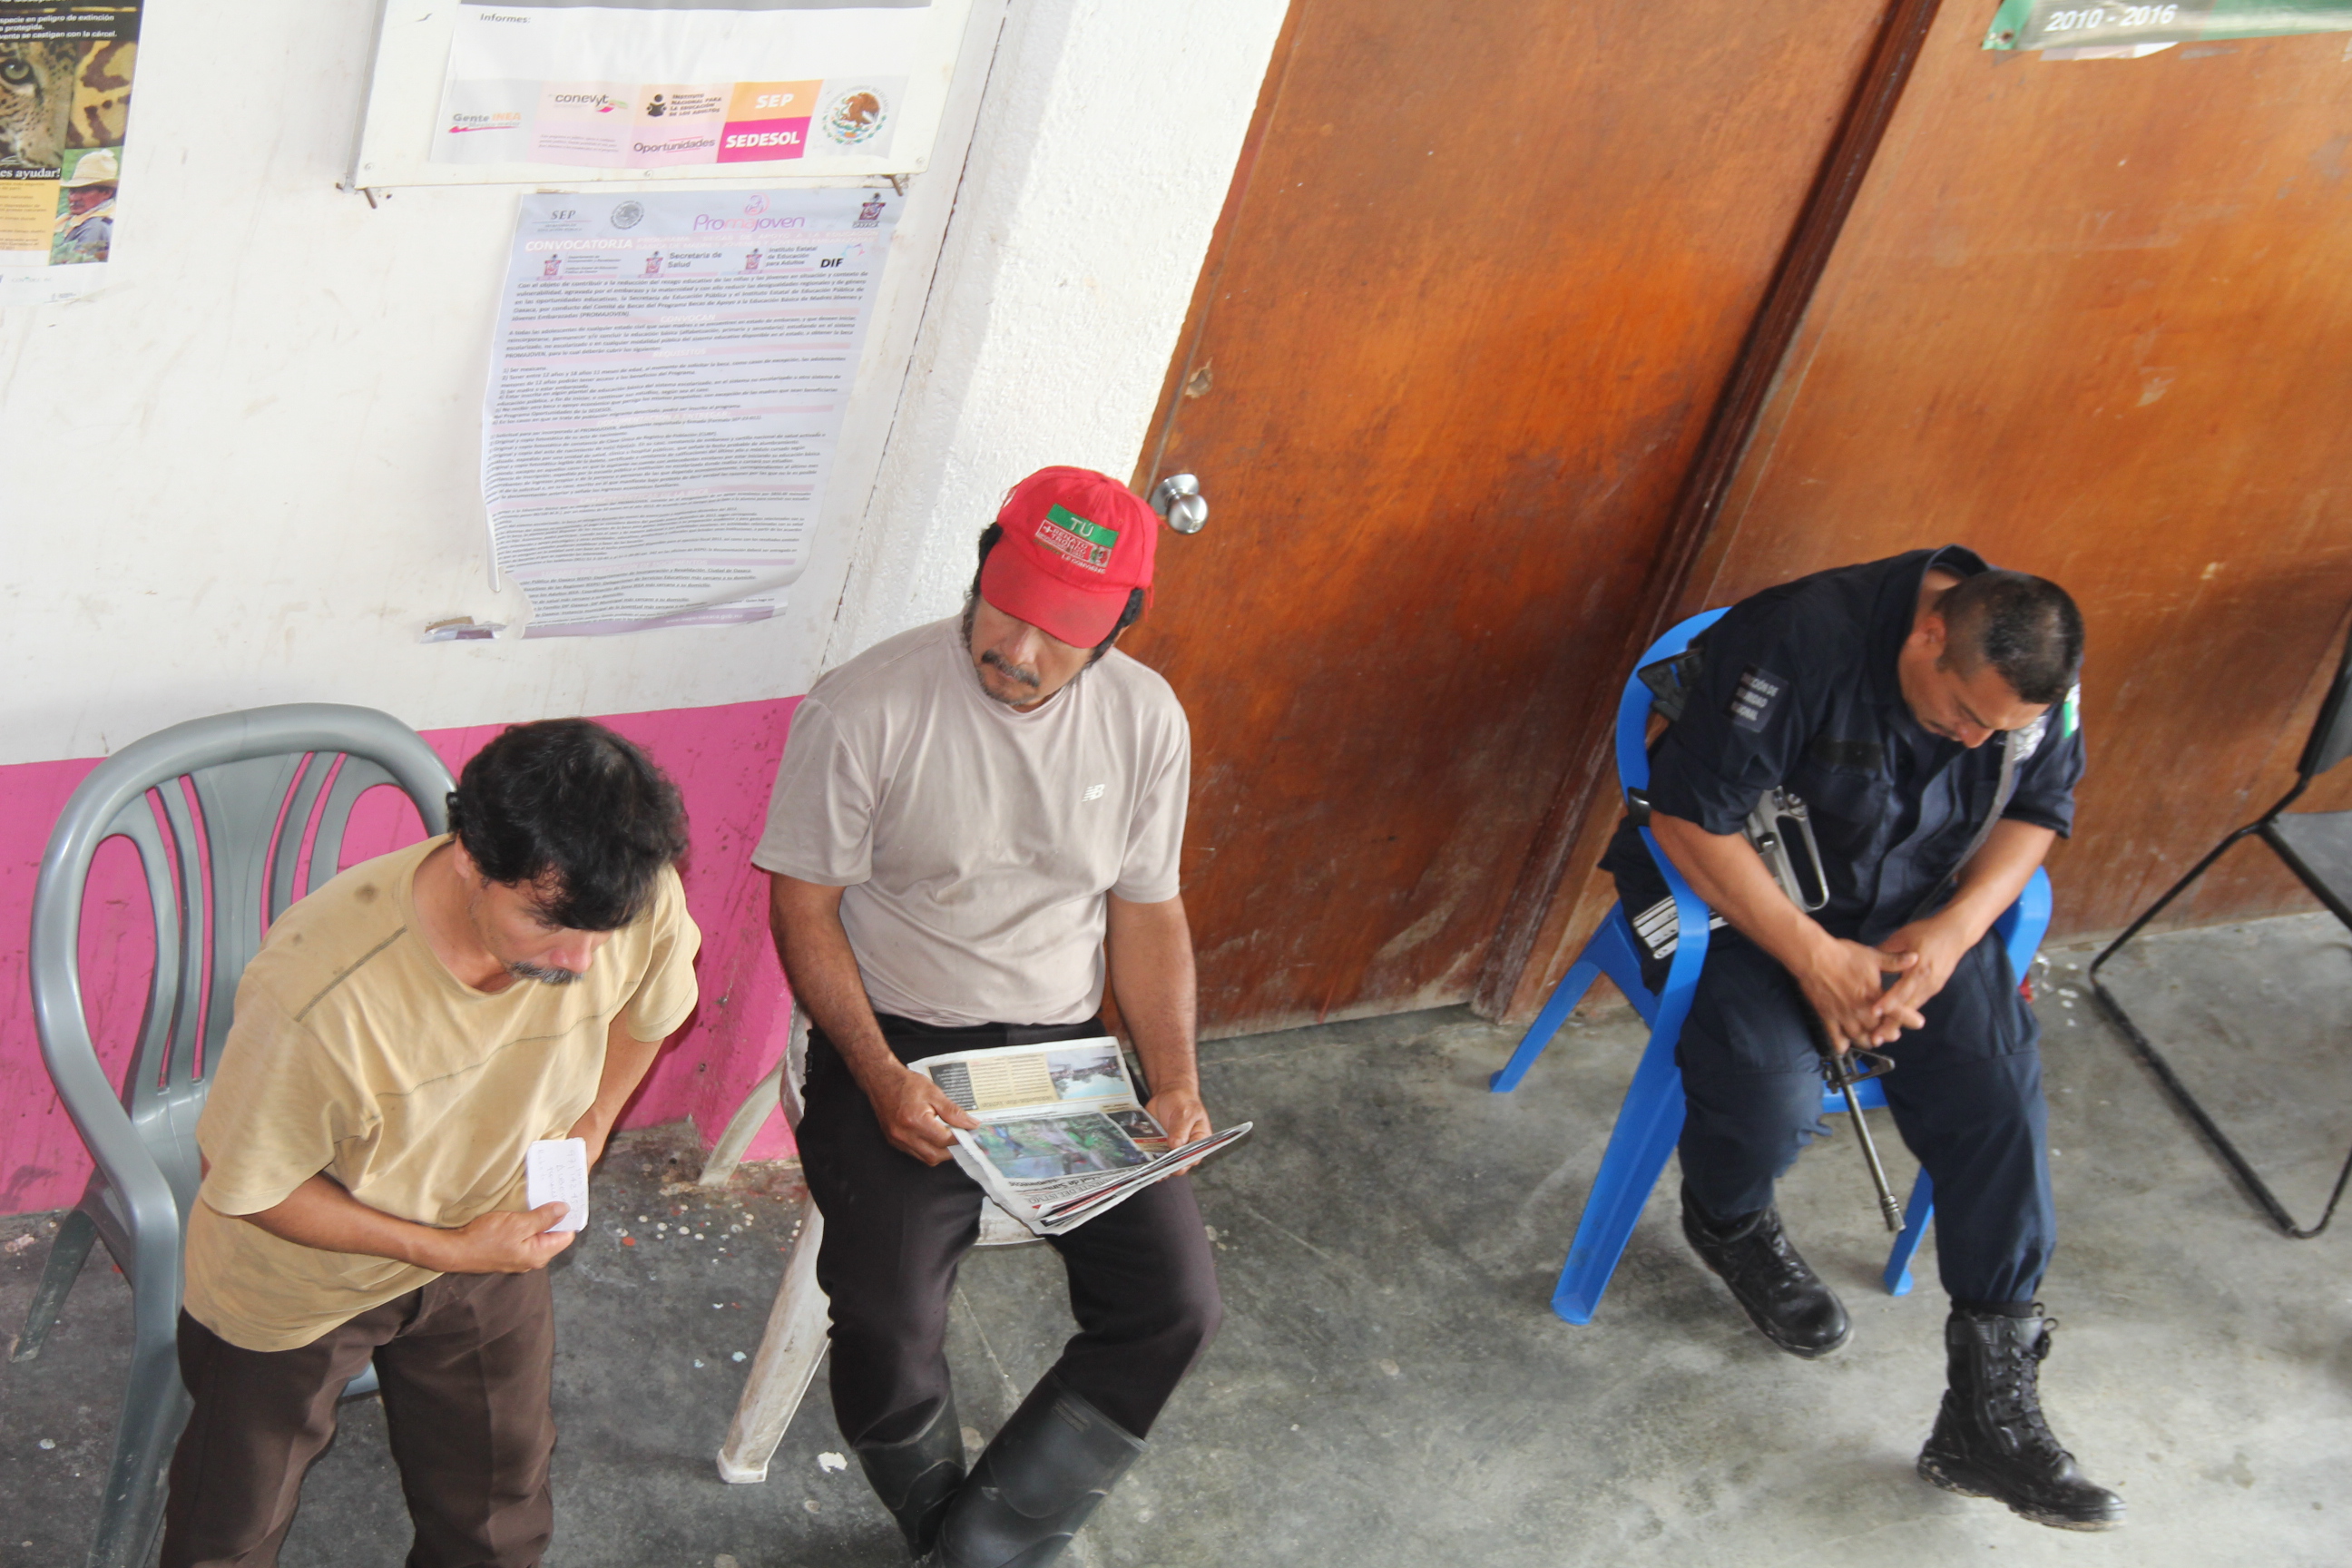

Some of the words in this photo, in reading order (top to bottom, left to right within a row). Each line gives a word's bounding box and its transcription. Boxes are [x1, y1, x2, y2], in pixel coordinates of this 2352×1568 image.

[0, 16, 24, 24] specie
[37, 15, 65, 24] peligro
[66, 14, 77, 22] de
[78, 13, 114, 22] extinción
[480, 12, 531, 24] Informes:
[2043, 8, 2104, 33] 2010
[2119, 5, 2178, 28] 2016
[5, 24, 45, 33] protegida.
[32, 31, 65, 40] castigan
[92, 30, 118, 38] cárcel.
[554, 93, 610, 106] conevyt
[755, 93, 795, 109] SEP
[453, 113, 490, 122] Gente
[492, 112, 522, 121] INEA
[633, 138, 716, 154] Oportunidades
[725, 131, 801, 149] SEDESOL
[15, 167, 61, 180] ayudar!
[550, 210, 576, 220] SEP
[693, 213, 806, 232] Promajoven
[525, 238, 633, 252] CONVOCATORIA
[710, 250, 723, 260] de
[777, 251, 810, 260] Educación
[667, 260, 692, 269] Salud
[820, 258, 845, 269] DIF
[539, 280, 561, 289] objeto
[682, 276, 713, 284] educativo
[766, 272, 789, 281] jóvenes
[657, 284, 693, 292] maternidad
[756, 280, 799, 289] desigualdades
[799, 279, 830, 288] regionales
[845, 278, 867, 286] género
[535, 296, 582, 305] oportunidades
[671, 291, 703, 299] Educación
[800, 286, 831, 294] Educación
[657, 300, 688, 309] Programa
[716, 298, 736, 307] Apoyo
[537, 311, 579, 319] Embarazadas
[1070, 516, 1094, 537] TÚ
[1052, 528, 1088, 550] RENATO
[1028, 1191, 1059, 1204] ISTMO
